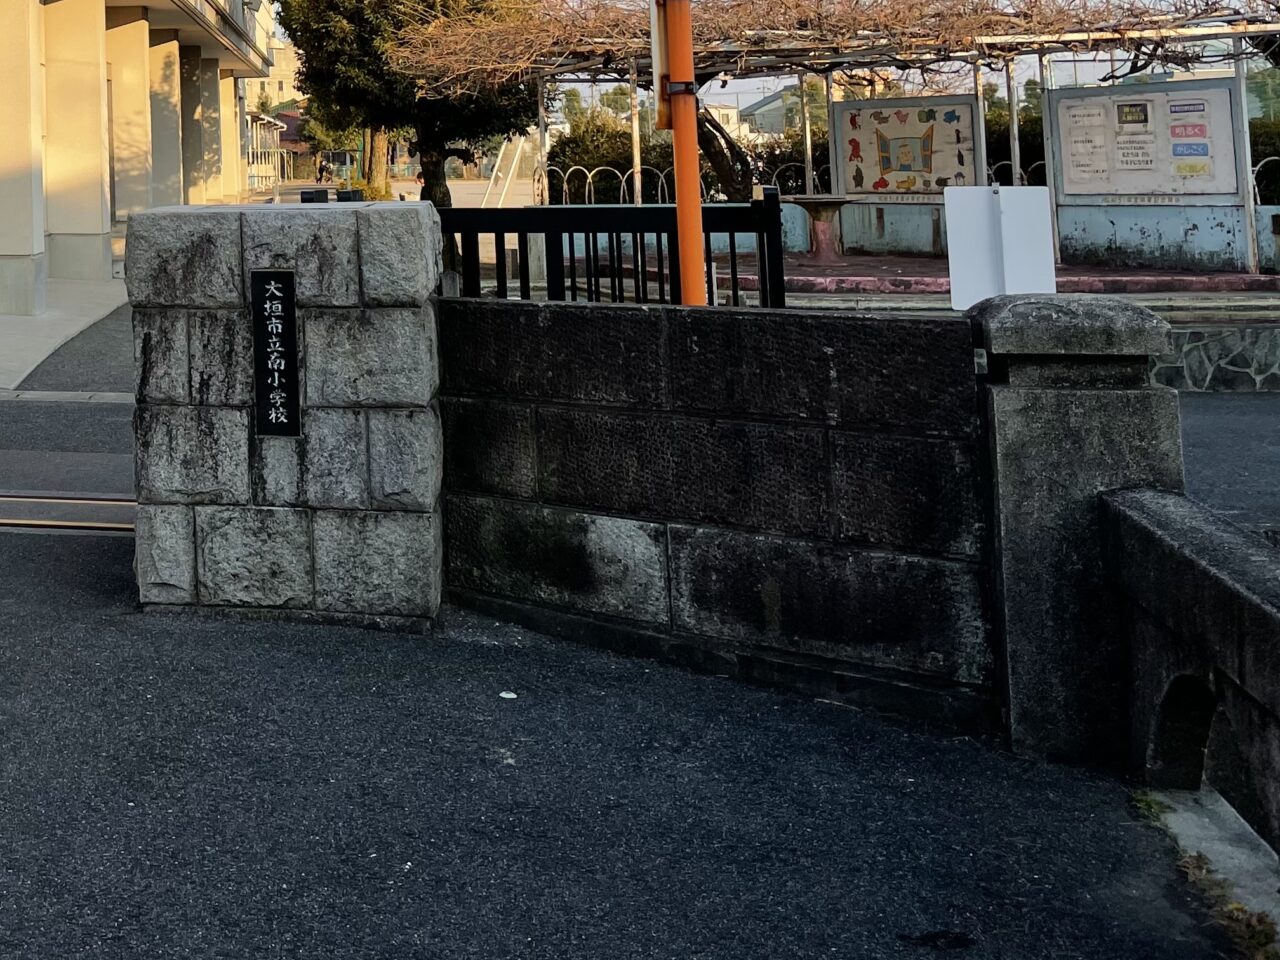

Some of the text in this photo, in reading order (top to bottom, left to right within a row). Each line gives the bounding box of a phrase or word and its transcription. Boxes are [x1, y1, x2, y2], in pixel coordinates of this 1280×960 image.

[1175, 126, 1200, 136] 明るく
[263, 280, 288, 423] 大垣市立南小学校
